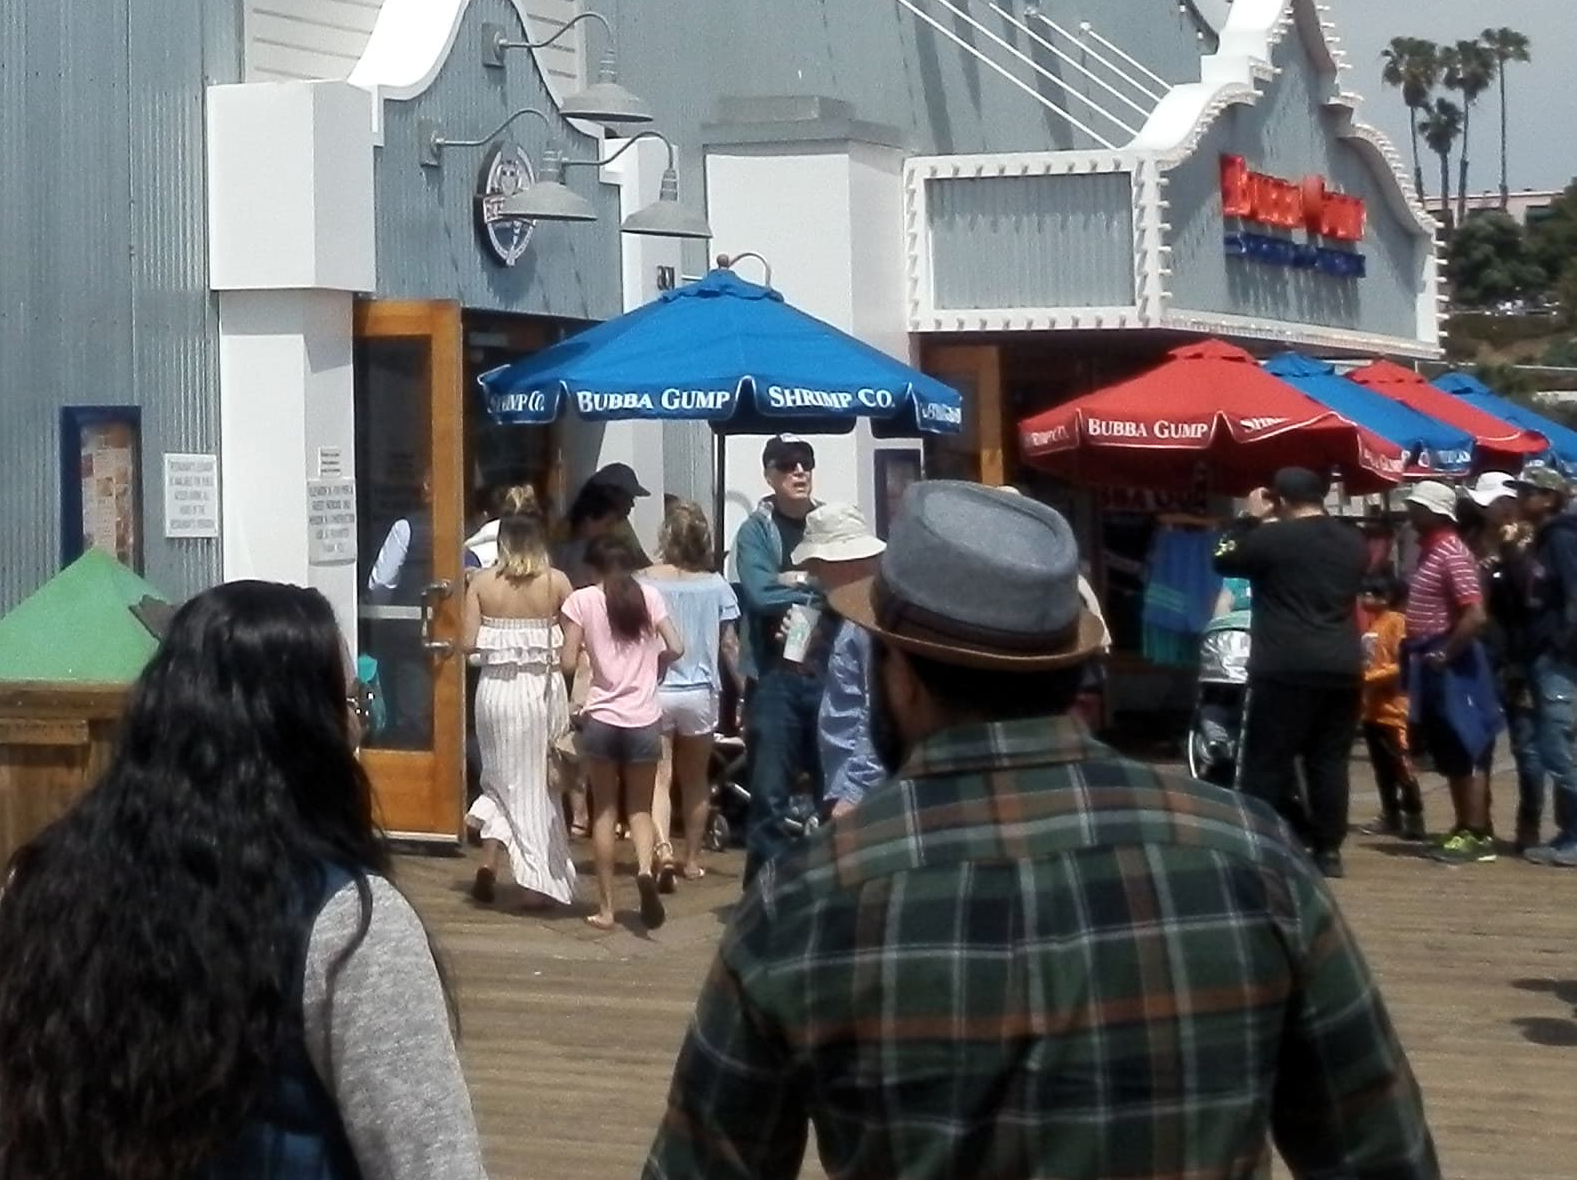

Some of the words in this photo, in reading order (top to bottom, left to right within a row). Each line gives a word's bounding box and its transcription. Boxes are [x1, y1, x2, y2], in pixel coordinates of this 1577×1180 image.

[576, 390, 654, 412] BUBBA
[661, 388, 731, 410] GUMP
[768, 386, 853, 409] SHRIMP
[857, 388, 896, 408] CO.
[1088, 418, 1147, 438] BUBBA
[1153, 419, 1209, 439] GUMP
